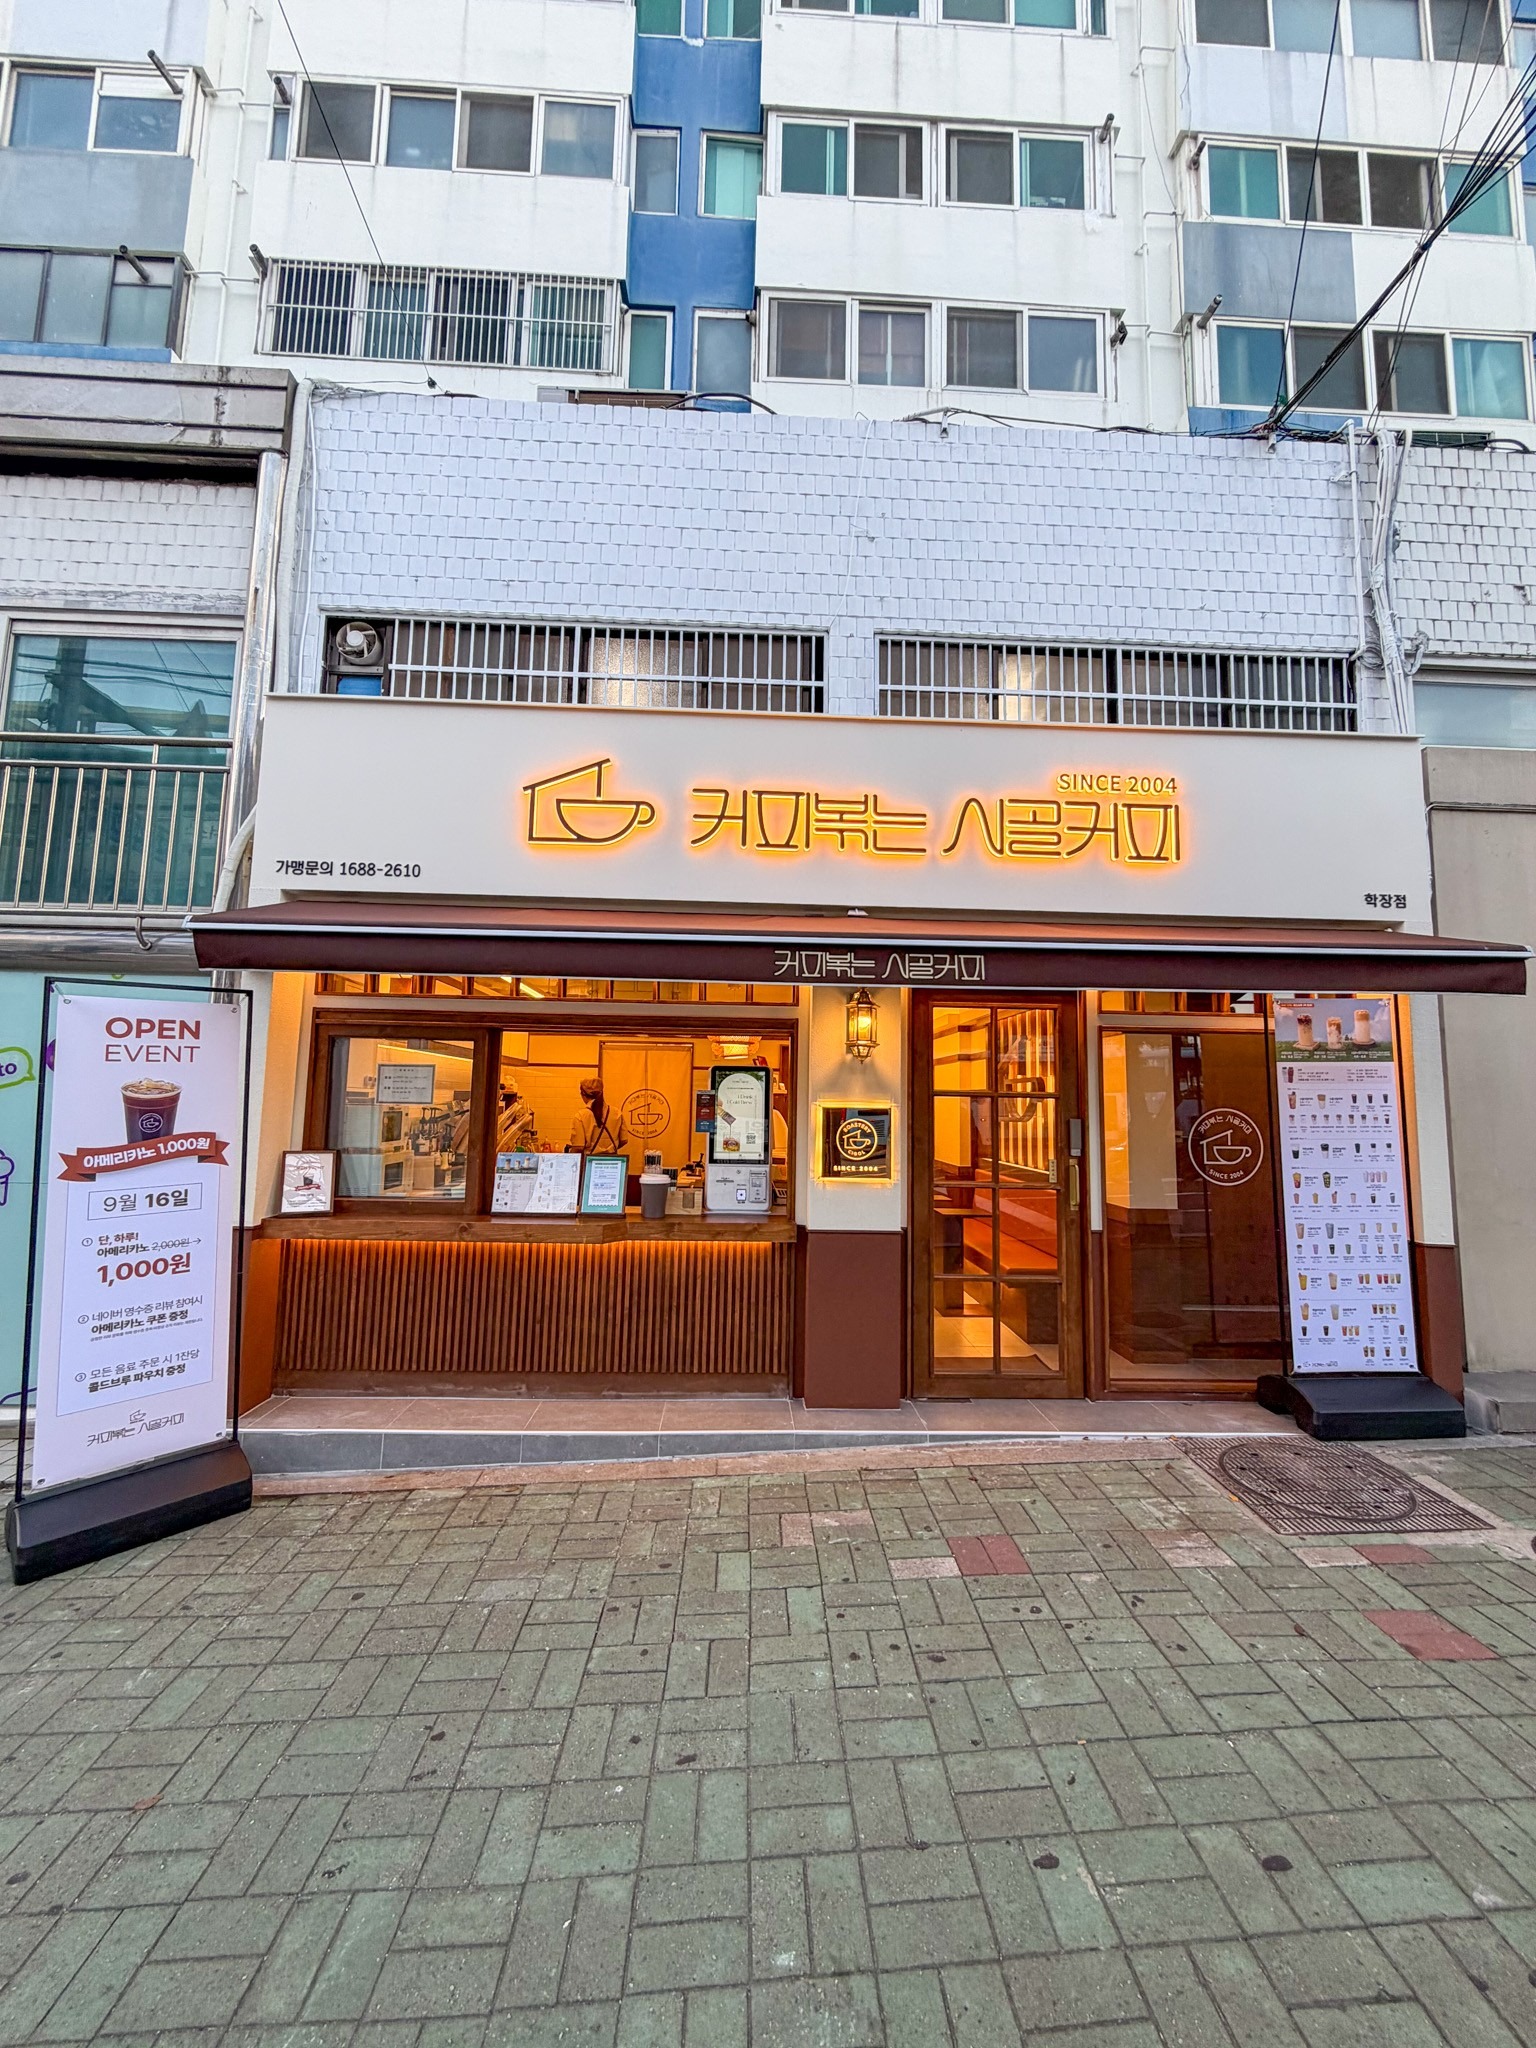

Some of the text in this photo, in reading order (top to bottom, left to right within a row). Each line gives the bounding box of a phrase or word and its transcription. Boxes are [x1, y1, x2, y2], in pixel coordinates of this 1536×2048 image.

[1057, 773, 1177, 794] SINCE 2004
[691, 788, 1180, 863] 커피볶는 시골커피
[275, 860, 421, 877] 가맹문의 1688-2610
[1364, 893, 1406, 908] 학장점
[774, 950, 985, 980] 커피볶는 시골커피
[105, 1017, 201, 1040] OPEN
[105, 1044, 201, 1063] EVENT
[843, 1122, 871, 1133] ROASTERY
[1198, 1115, 1252, 1135] 커피볶는 시골커피
[83, 1137, 211, 1168] 아메리카노 1,000원
[1209, 1169, 1244, 1179] SINCE 2004
[103, 1188, 188, 1212] 9월 16일
[97, 1238, 190, 1257] 아메리카노 2,000원
[98, 1235, 112, 1245] 단,
[114, 1232, 139, 1243] 하루!
[97, 1252, 191, 1287] 1,000원
[92, 1308, 122, 1321] 네이버
[124, 1303, 154, 1317] 영수증
[155, 1300, 174, 1311] 리뷰
[175, 1295, 203, 1309] 참여시
[91, 1318, 145, 1334] 아메리카노
[146, 1313, 167, 1325] 쿠폰
[169, 1309, 189, 1321] 증정
[90, 1366, 113, 1379] 모든
[115, 1362, 136, 1375] 음료
[139, 1357, 160, 1369] 주문
[162, 1354, 172, 1364] 시
[175, 1349, 200, 1361] 1잔당
[88, 1363, 186, 1393] 콜드브루 파우치 증정
